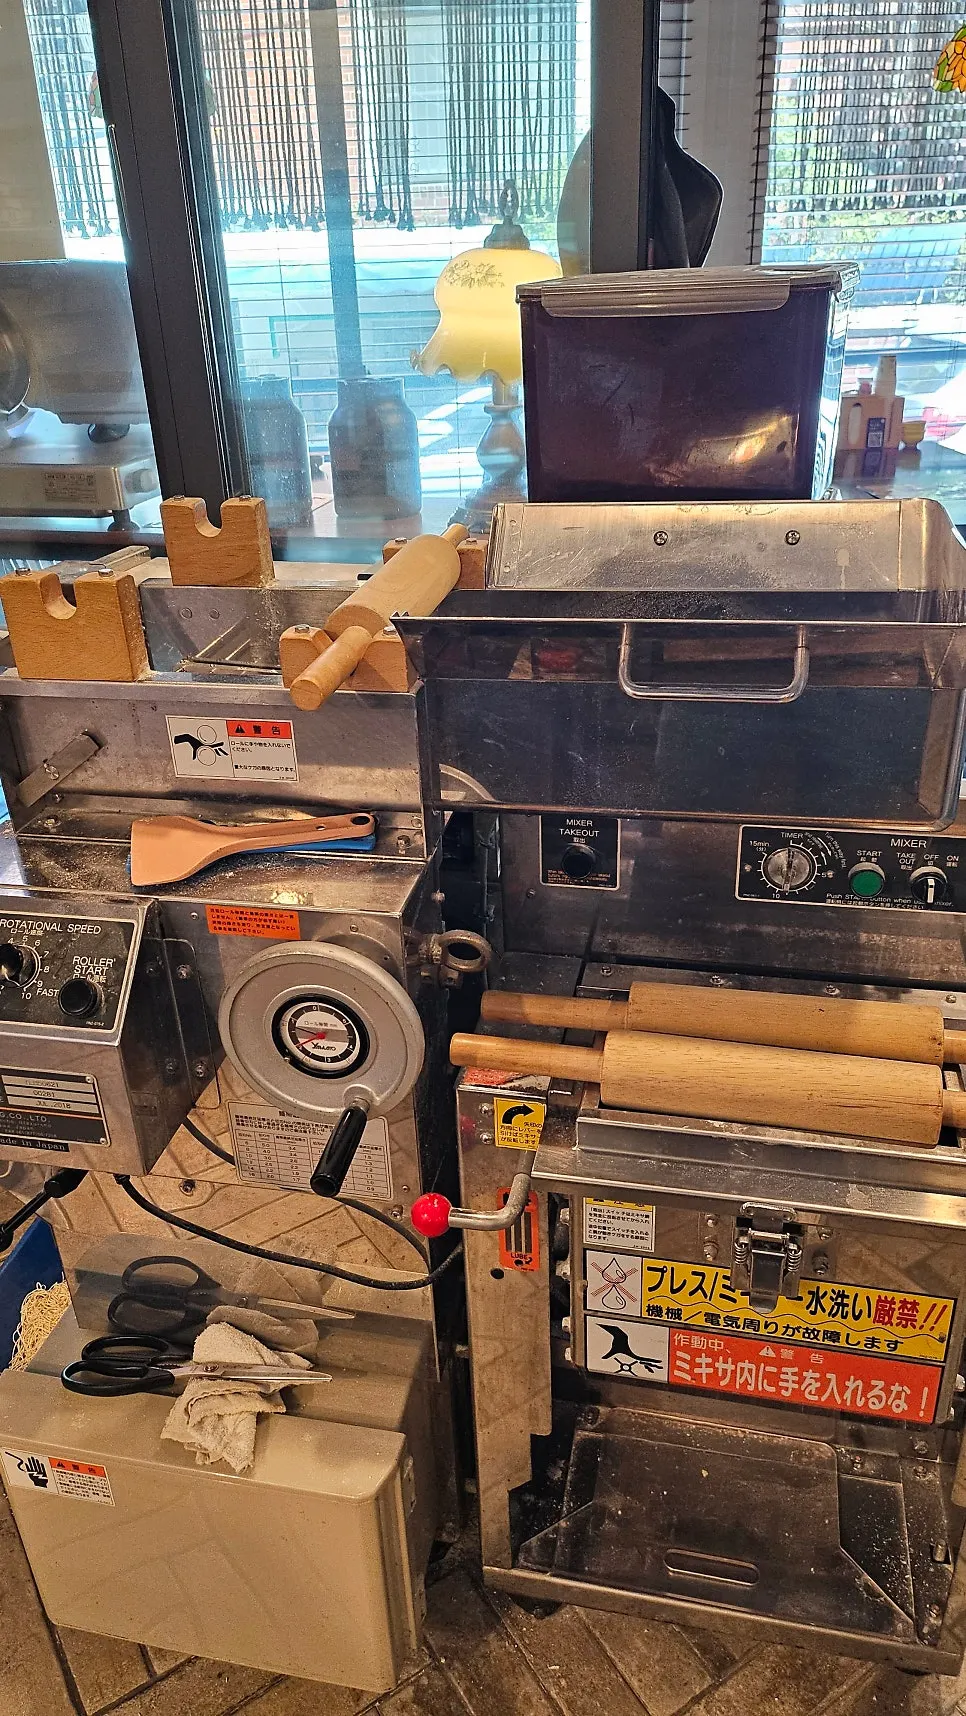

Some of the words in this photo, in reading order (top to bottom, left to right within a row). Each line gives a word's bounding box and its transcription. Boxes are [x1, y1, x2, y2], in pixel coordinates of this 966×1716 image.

[566, 818, 593, 827] MIXER
[559, 828, 600, 837] TAKEOUT
[780, 831, 804, 839] TIMER
[890, 838, 927, 848] MIXER
[0, 919, 63, 932] ROTATIONAL
[67, 923, 101, 934] SPEED
[73, 956, 113, 968] ROLLER
[74, 965, 109, 976] START
[22, 992, 31, 1000] 10
[36, 988, 59, 997] FAST
[35, 1142, 66, 1151] Japan
[510, 1252, 528, 1260] LUBE
[673, 1350, 928, 1418] ミキサ内に手を入れるな!
